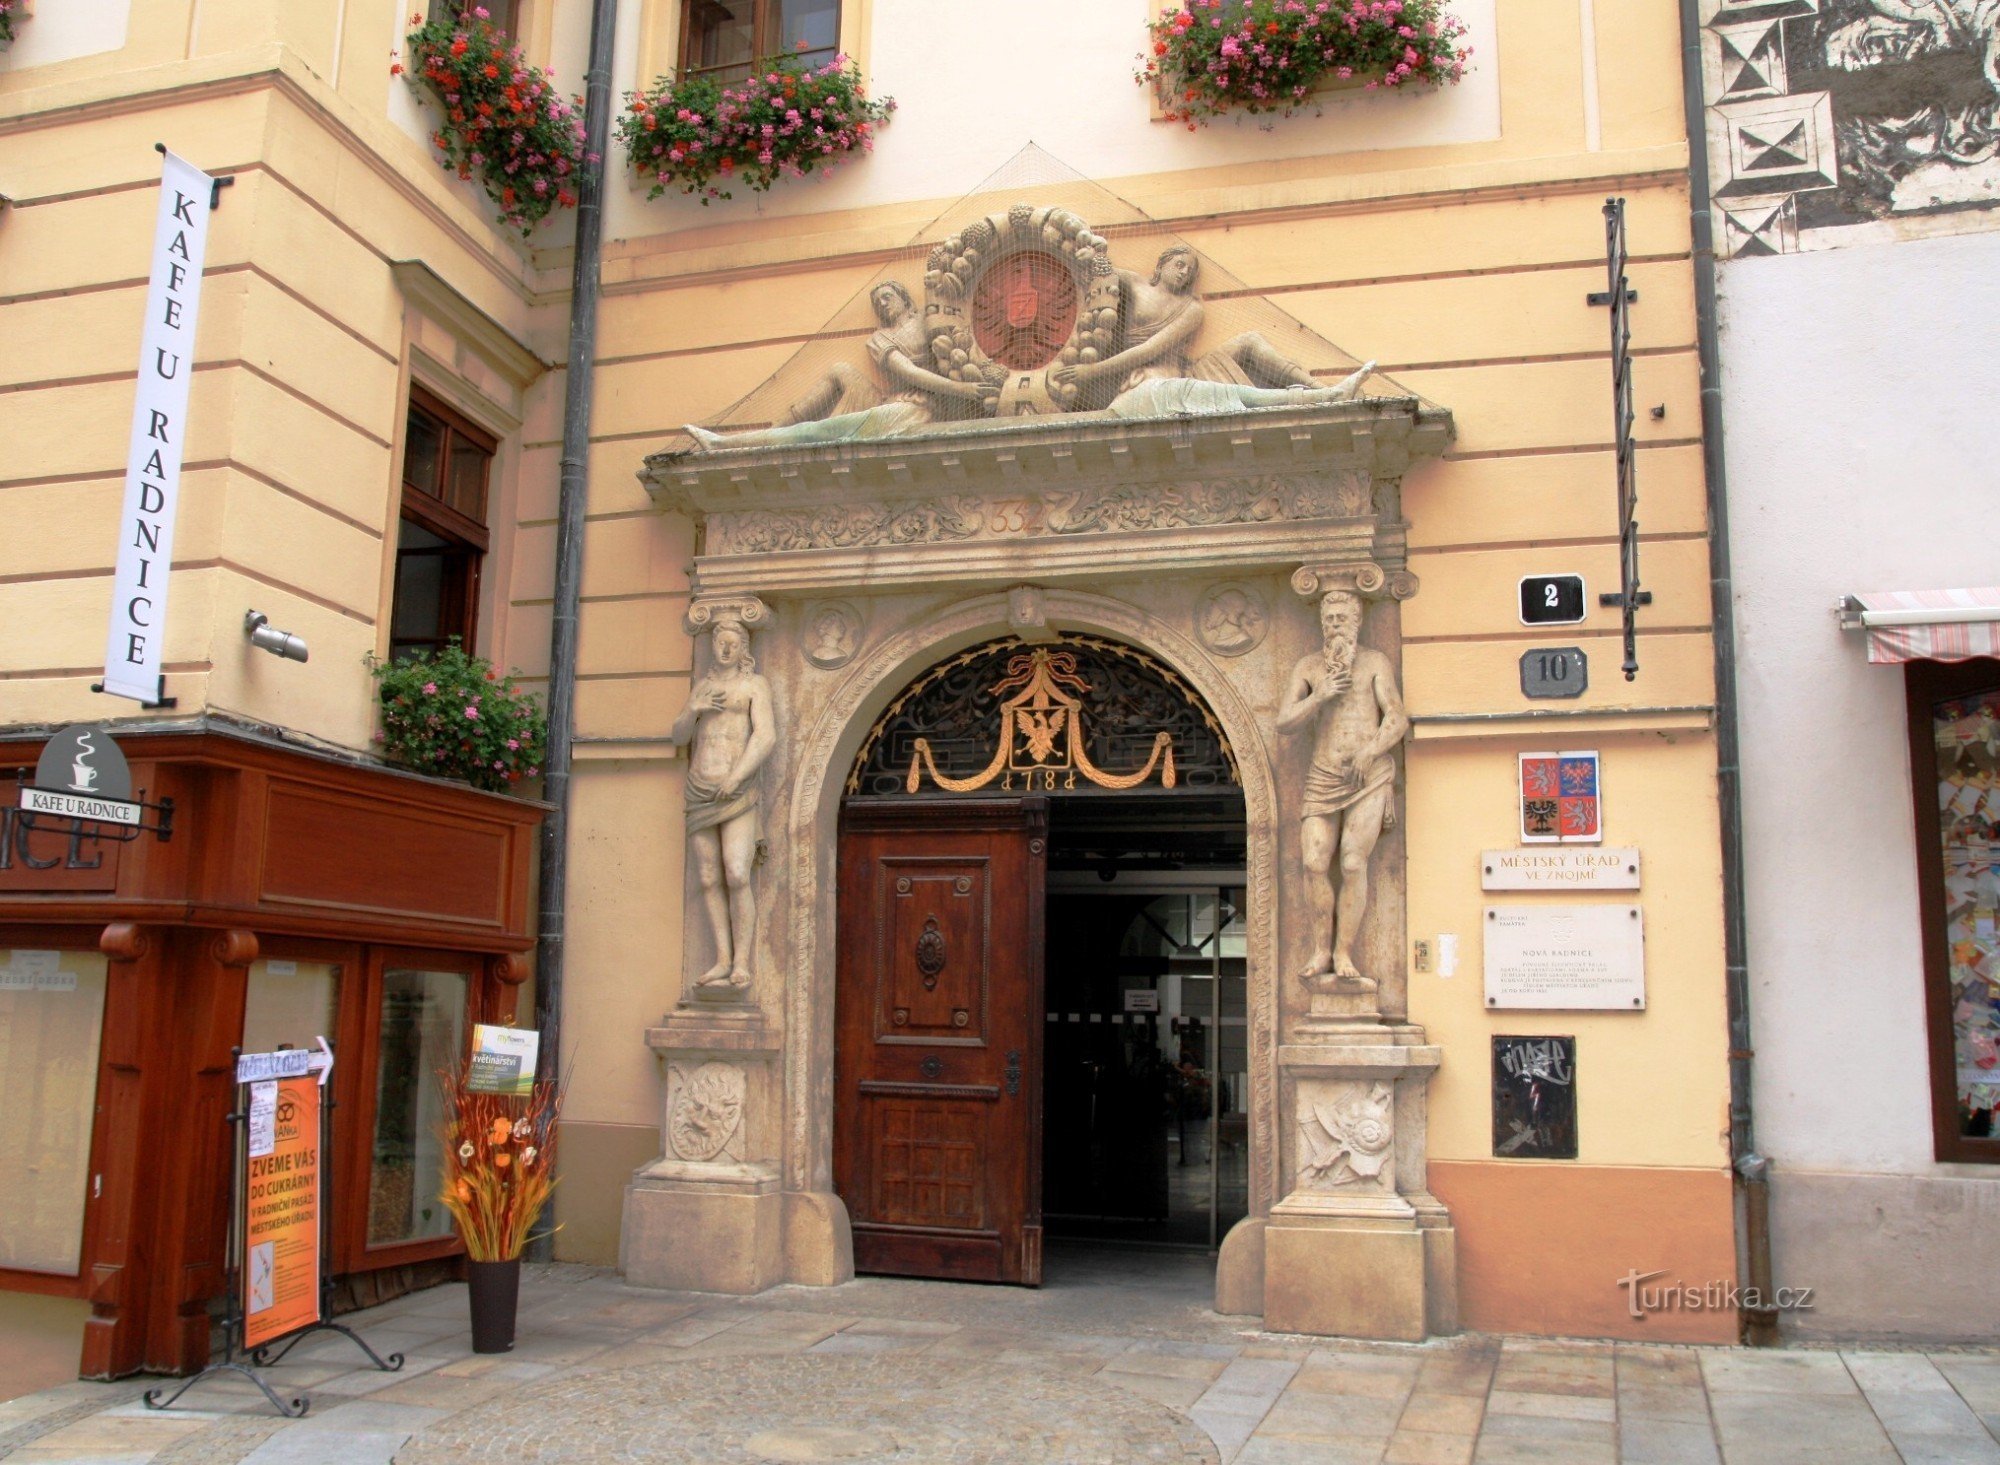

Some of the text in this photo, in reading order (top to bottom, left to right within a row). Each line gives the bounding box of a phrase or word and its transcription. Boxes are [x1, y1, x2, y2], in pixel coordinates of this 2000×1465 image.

[126, 190, 197, 665] KAFE U RADNICE
[1544, 583, 1559, 607] 2
[1538, 654, 1568, 681] 10
[32, 794, 130, 820] KAFE U RADNICE
[1525, 871, 1540, 881] VE
[252, 1148, 316, 1178] ZVEME VÁS
[251, 1172, 315, 1200] DO CUKRÁRNY
